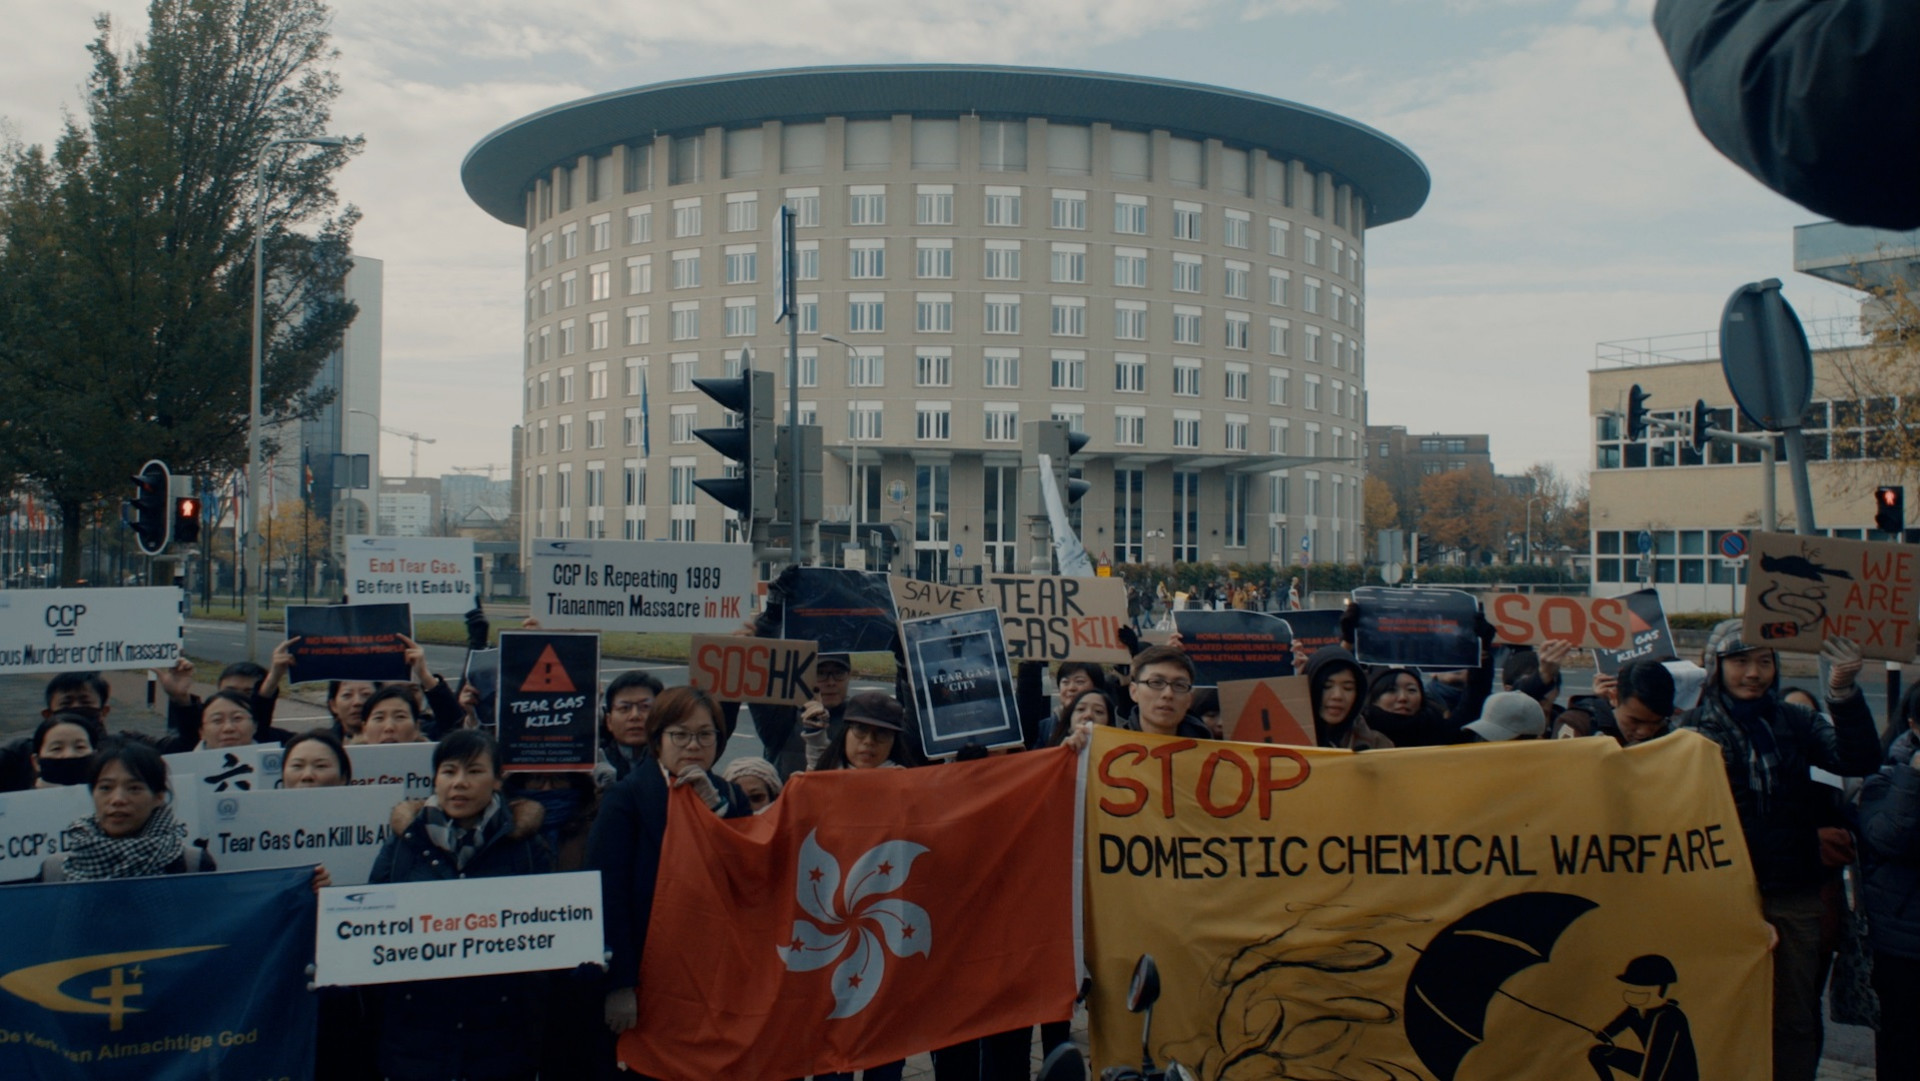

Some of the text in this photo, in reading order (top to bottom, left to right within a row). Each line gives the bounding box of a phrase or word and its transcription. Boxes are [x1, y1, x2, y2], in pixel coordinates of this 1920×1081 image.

[369, 558, 461, 574] End Tear Gas.
[553, 563, 721, 594] CCP Is Repeating 1989
[1862, 551, 1913, 583] WE
[356, 579, 471, 594] Before It Ends Us
[903, 581, 964, 610] SAVE
[991, 578, 1084, 617] TEAR
[1845, 583, 1912, 615] ARE
[45, 604, 87, 628] CCP
[547, 592, 741, 619] Tiananmen Massacre in HK
[1494, 594, 1625, 649] SOS
[1771, 621, 1798, 638] CS
[1821, 614, 1910, 647] NEXT
[374, 634, 395, 644] GAS
[1003, 617, 1070, 660] GAS
[1196, 633, 1274, 641] HONG KONG POLICE
[1634, 629, 1660, 645] GAS
[0, 640, 178, 666] ous Murderer of HK massacre
[1617, 643, 1653, 663] KILLS
[931, 669, 990, 685] TEAR GAS
[949, 680, 976, 692] CITY
[510, 695, 586, 714] TEAR GAS
[525, 712, 573, 728] KILLS
[350, 778, 376, 786] ear
[407, 772, 431, 789] Pro
[1098, 739, 1311, 821] STOP
[8, 833, 57, 858] CCP's
[219, 824, 390, 854] Tear Gas Can Kill Us Al
[1099, 824, 1732, 879] DOMESTIC CHEMICAL WARFARE
[337, 905, 593, 940] Control Tear Gas Production
[372, 944, 418, 966] Save
[421, 941, 457, 961] Our
[98, 1032, 213, 1061] Almachtige
[217, 1028, 257, 1047] God
